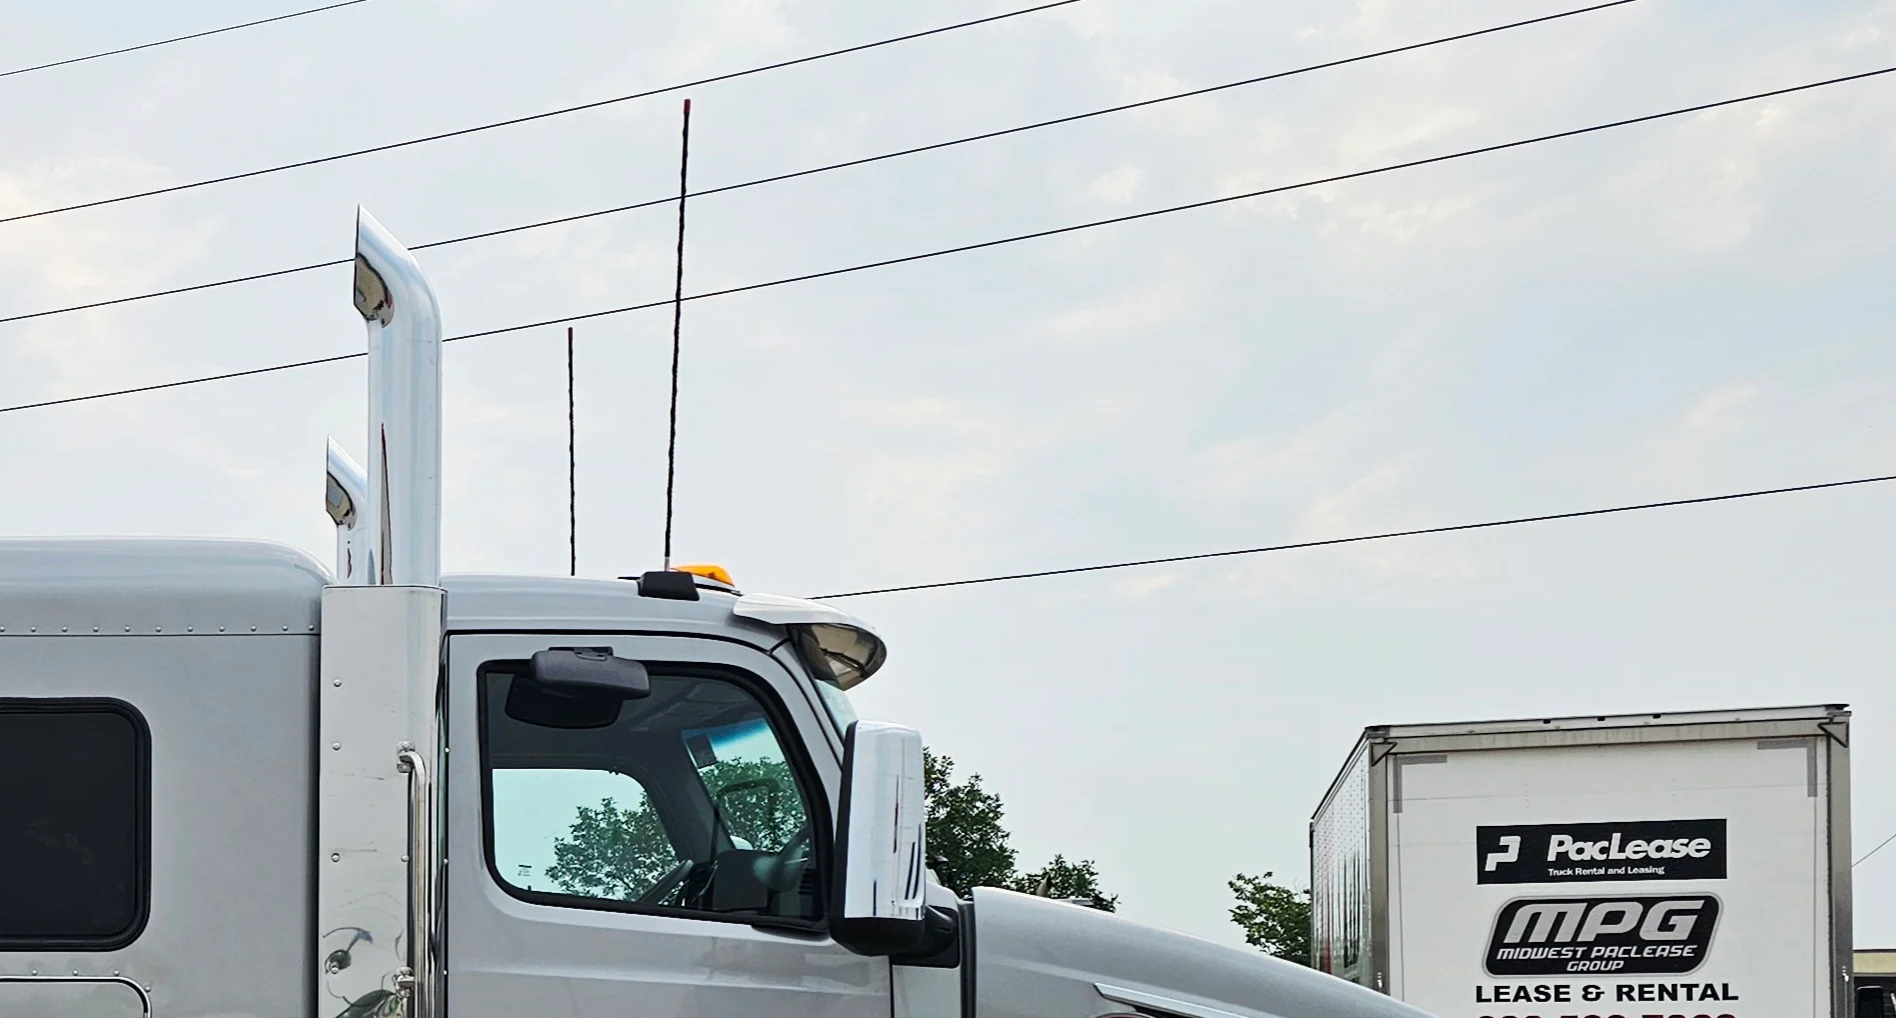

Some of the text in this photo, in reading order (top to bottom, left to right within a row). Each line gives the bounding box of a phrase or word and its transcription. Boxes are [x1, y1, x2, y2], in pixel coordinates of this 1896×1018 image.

[1547, 832, 1711, 862] PacLease
[1548, 865, 1665, 876] Truck Rental and Leasing
[1503, 900, 1705, 944] MPG
[1497, 945, 1698, 960] MIDWEST PACLEASE
[1566, 960, 1624, 972] GROUP
[1476, 983, 1739, 1003] LEASE & RENTAL
